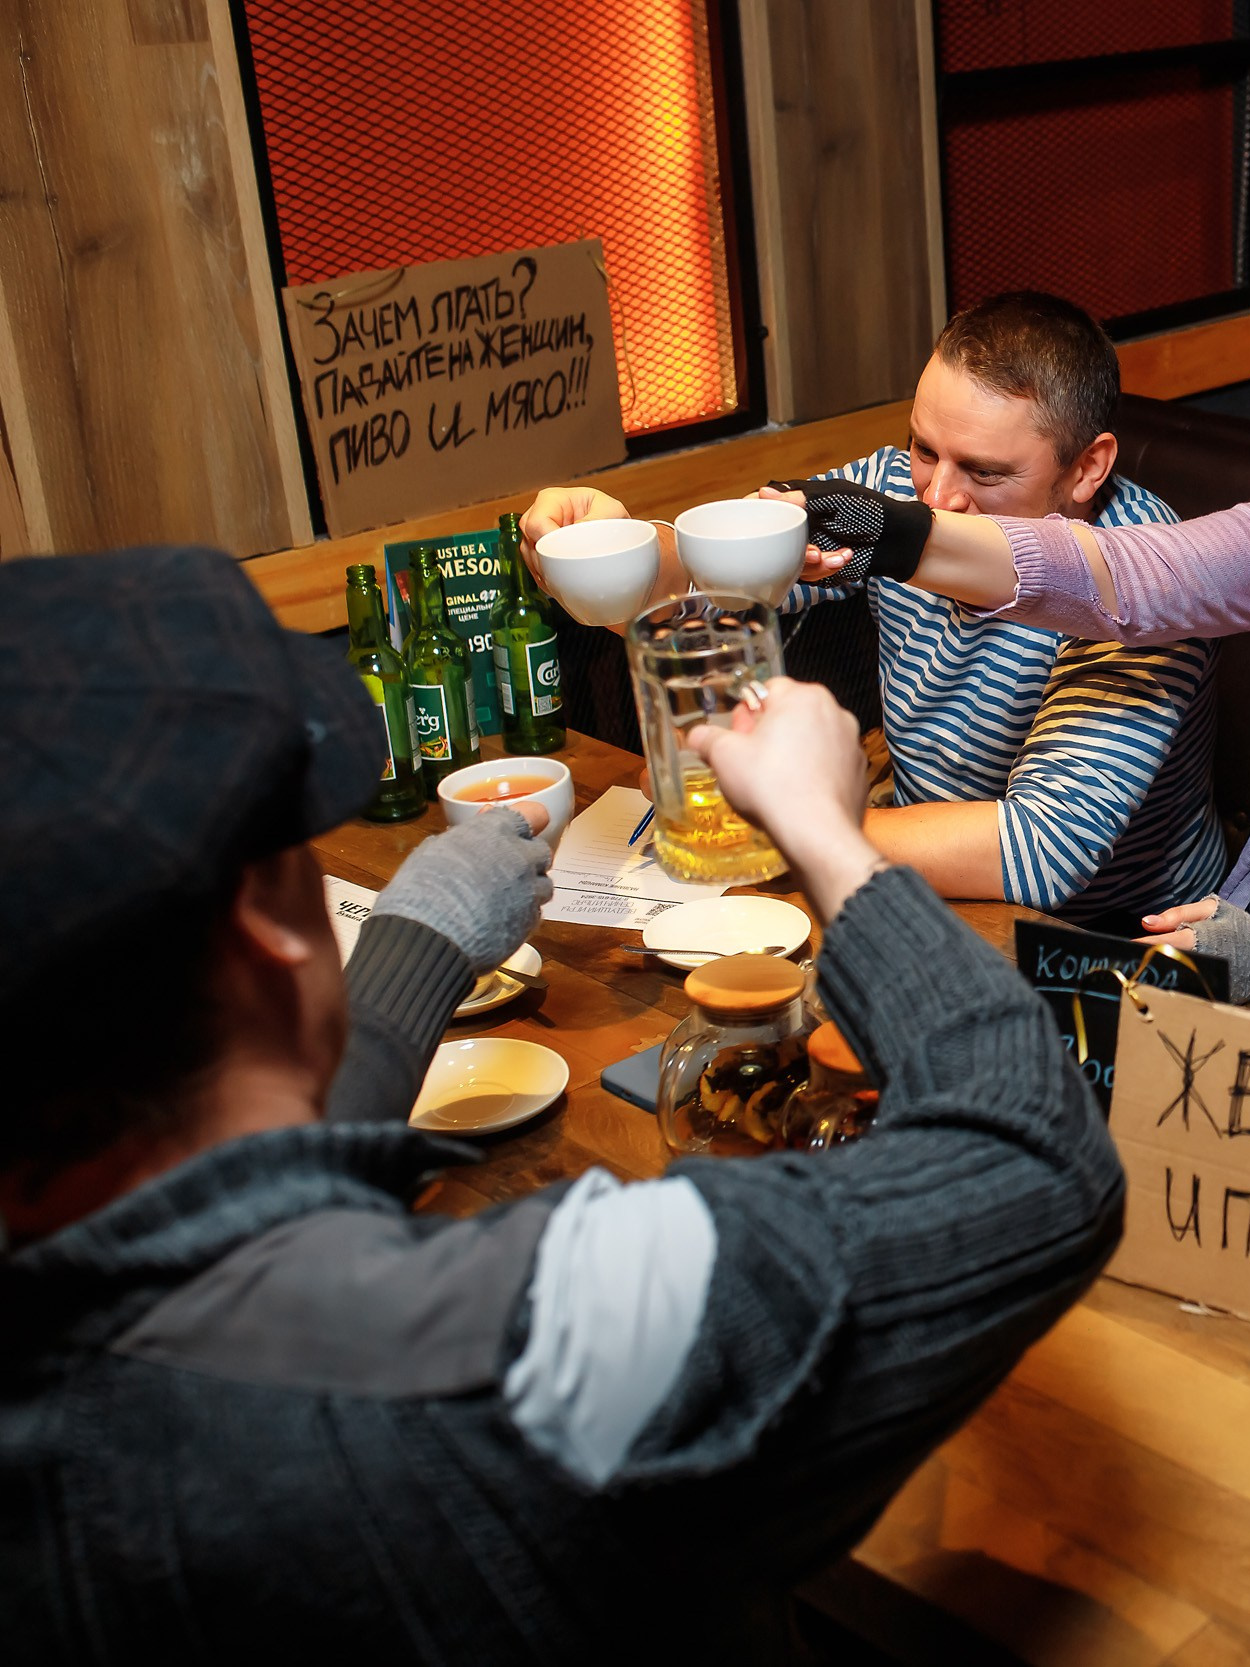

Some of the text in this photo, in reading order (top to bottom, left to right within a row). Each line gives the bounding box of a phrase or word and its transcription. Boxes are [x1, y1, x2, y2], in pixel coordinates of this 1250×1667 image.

[313, 256, 537, 365] ЗАЧЕМ ЛГАТЬ?
[329, 356, 592, 485] ПИВО И МЯСО!!!
[436, 543, 487, 560] UST BE A
[437, 557, 500, 579] MESON
[446, 593, 480, 606] GINAL
[458, 613, 479, 623] ЦЕНЕ
